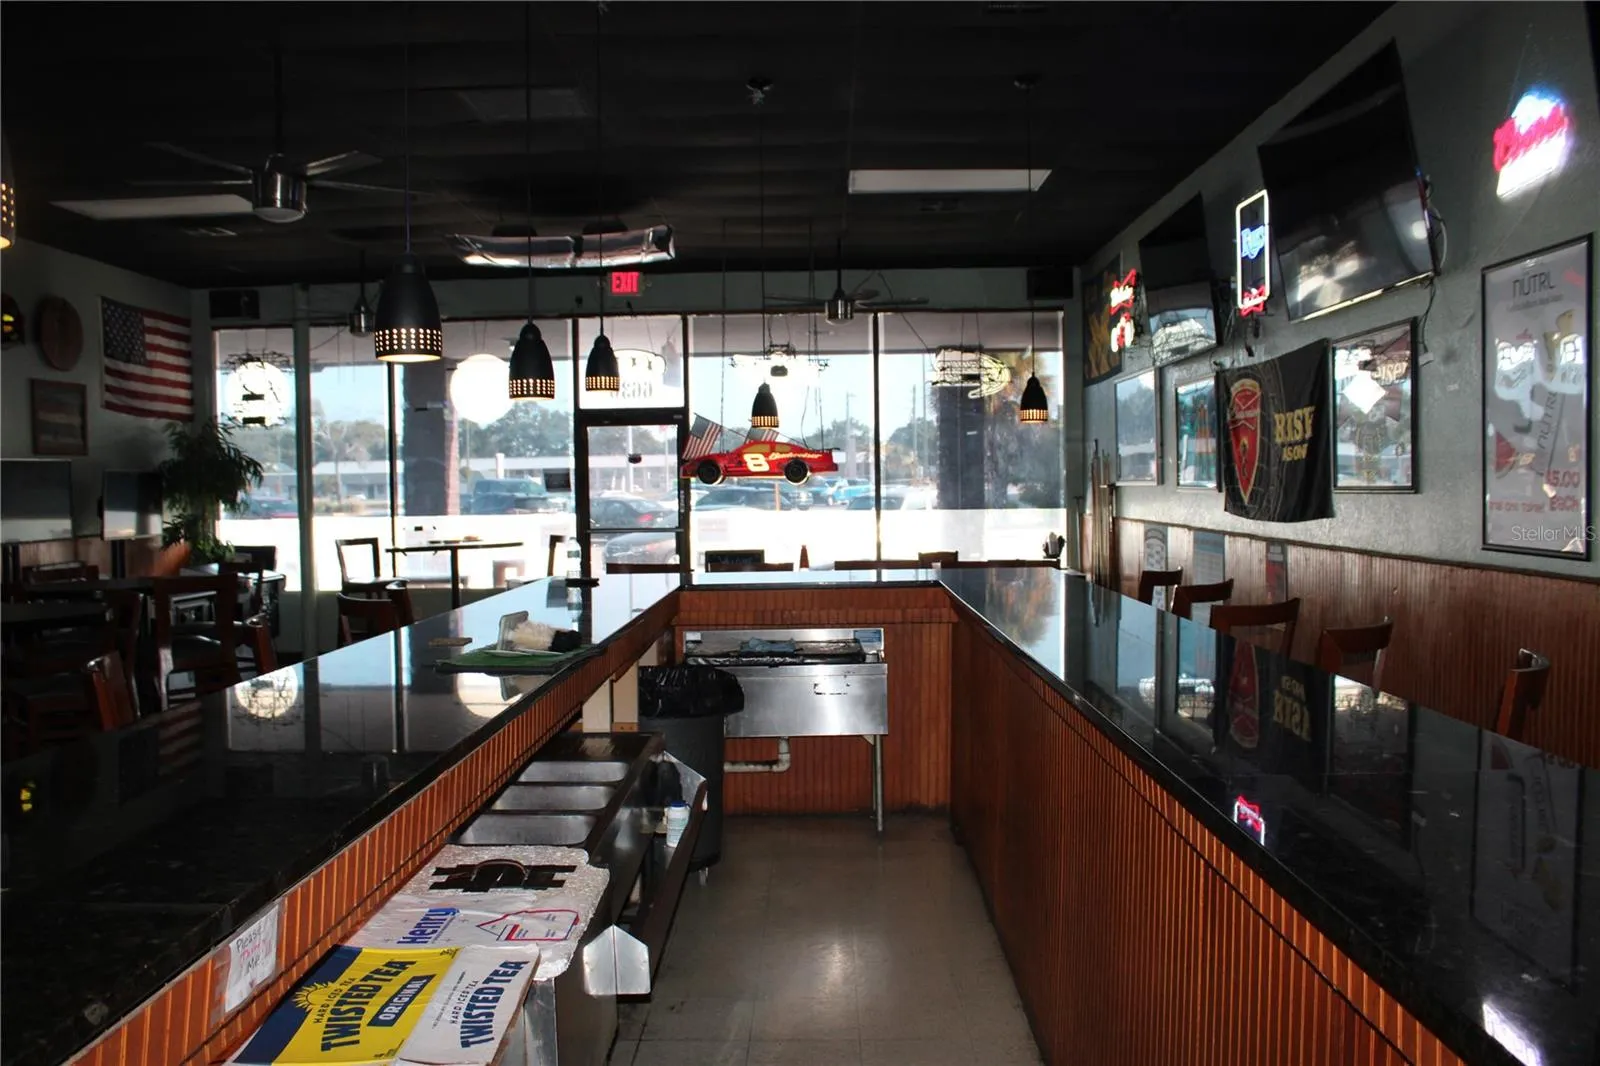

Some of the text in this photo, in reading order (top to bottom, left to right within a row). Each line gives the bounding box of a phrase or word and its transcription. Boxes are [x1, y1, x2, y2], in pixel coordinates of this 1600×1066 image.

[612, 272, 640, 294] EXIT
[743, 453, 770, 472] 8
[397, 907, 461, 944] Henry
[313, 977, 358, 1023] HARD ICED TEA
[321, 984, 383, 1052] TWISTED
[360, 960, 417, 983] TEA
[378, 978, 428, 1021] ORIGINAL
[450, 980, 479, 1024] HARD ICED TEA
[460, 960, 530, 1048] TWISTED TEA
